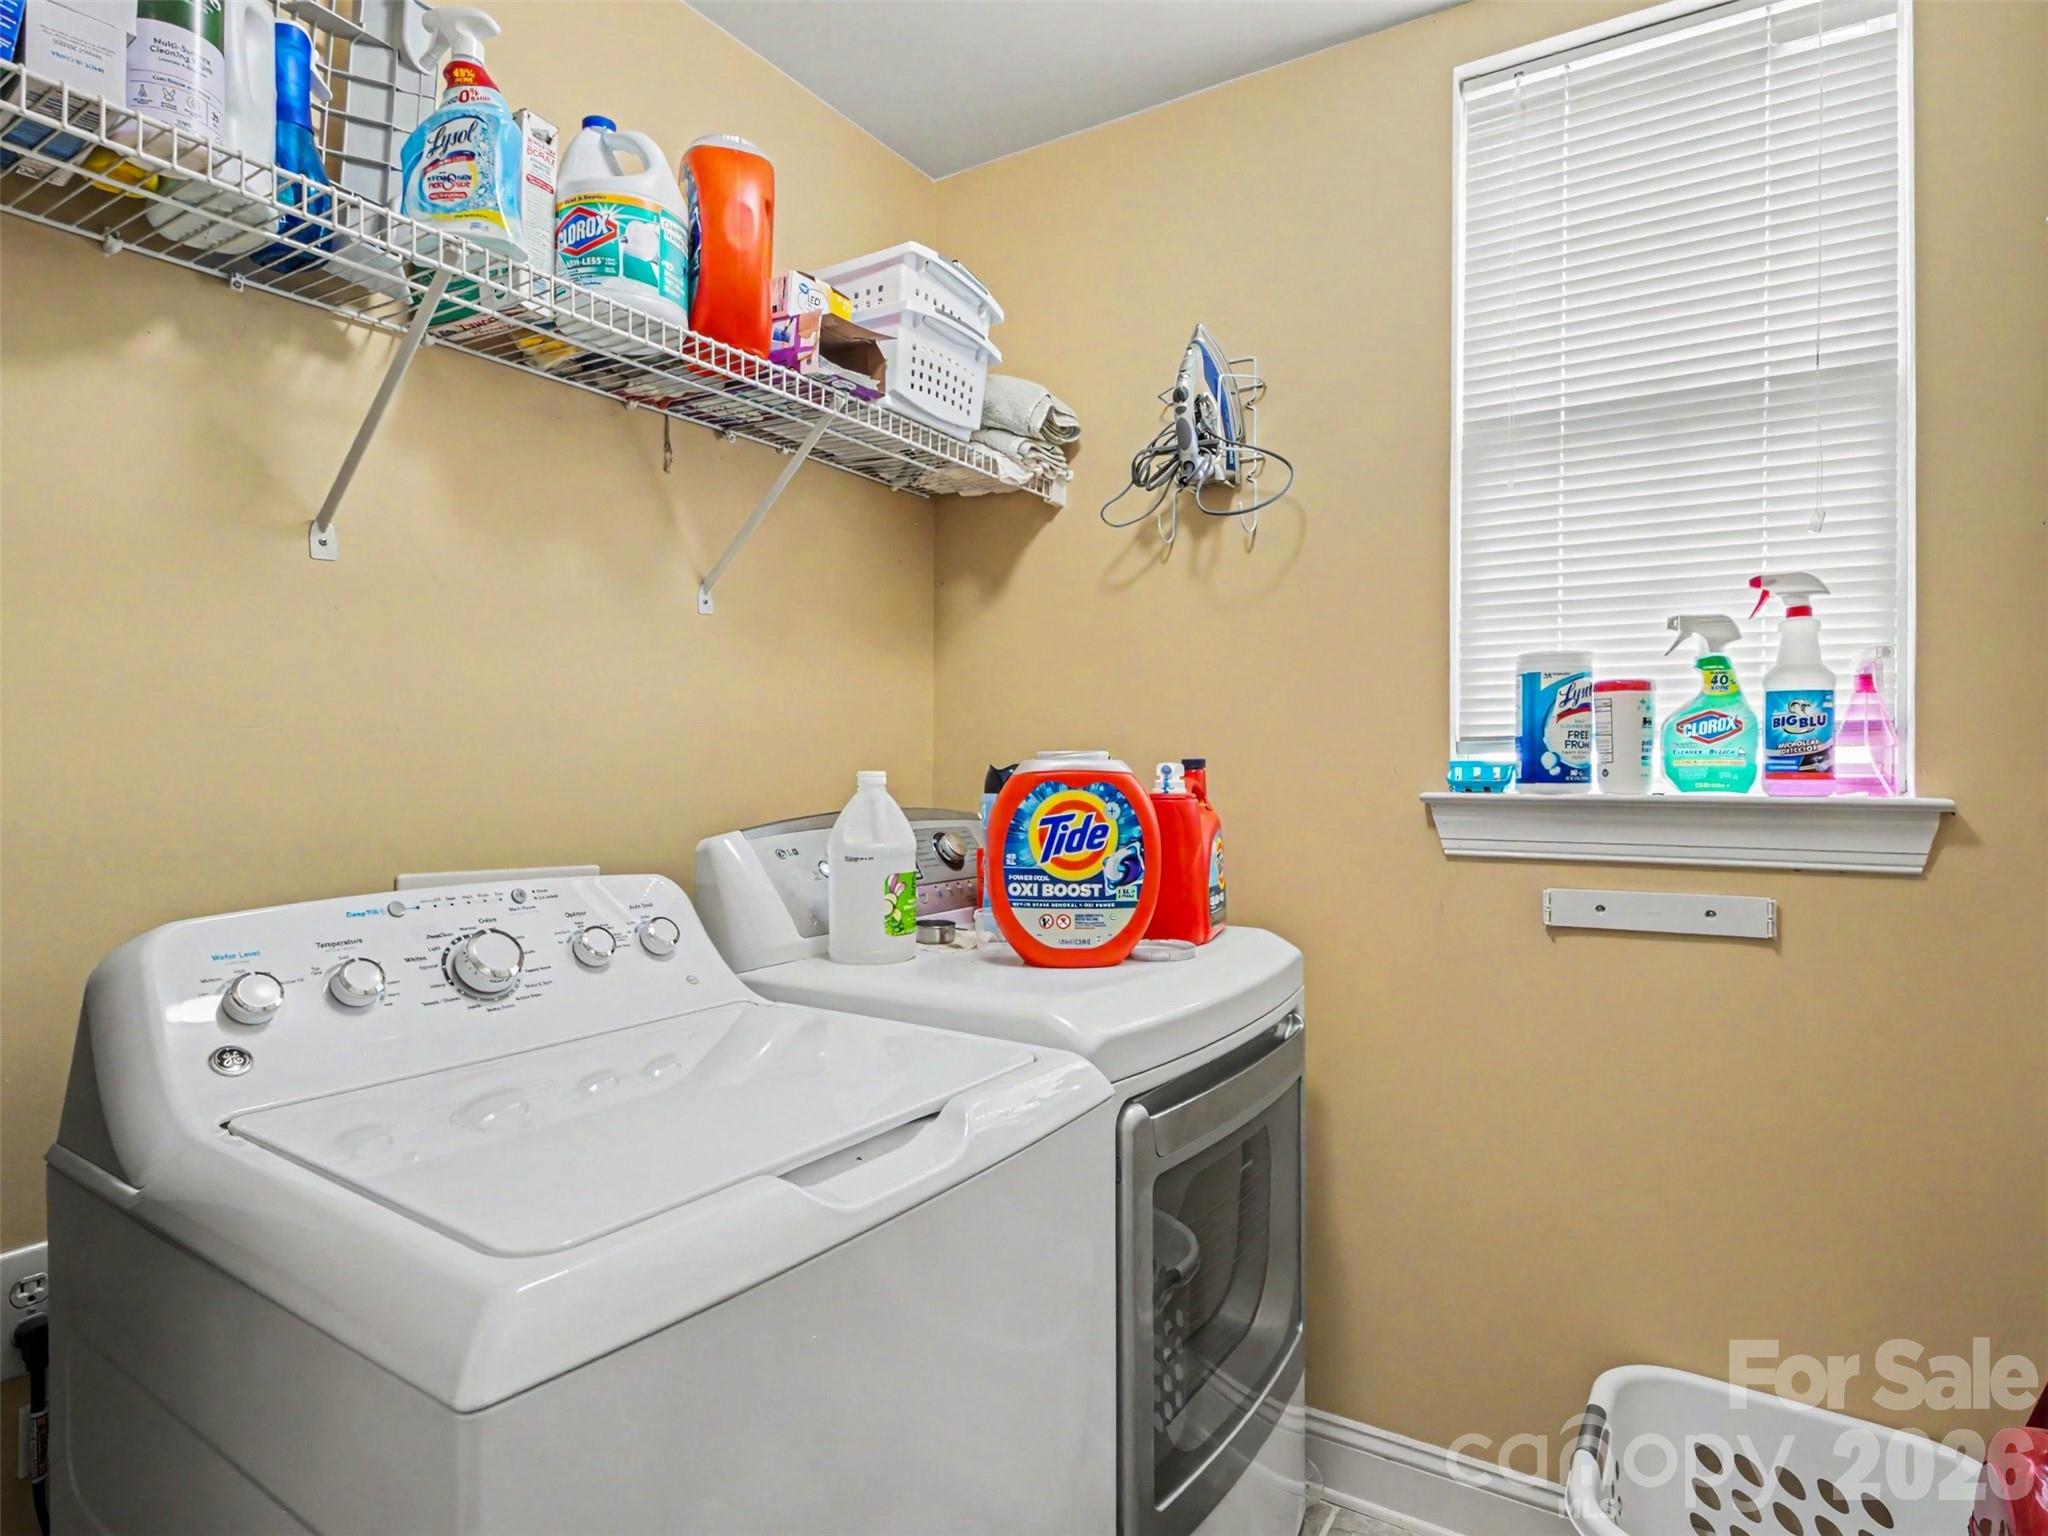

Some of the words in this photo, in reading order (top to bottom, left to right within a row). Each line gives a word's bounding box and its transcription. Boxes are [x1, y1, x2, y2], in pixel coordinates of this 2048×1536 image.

[426, 119, 479, 159] Lysol
[1683, 717, 1736, 738] CLOROX
[1567, 730, 1589, 740] FREE
[1039, 811, 1110, 864] Tide
[1008, 883, 1038, 897] OXI
[1042, 883, 1103, 897] BOOST
[315, 938, 364, 949] Temperature
[211, 953, 236, 961] Water
[238, 950, 260, 958] Level
